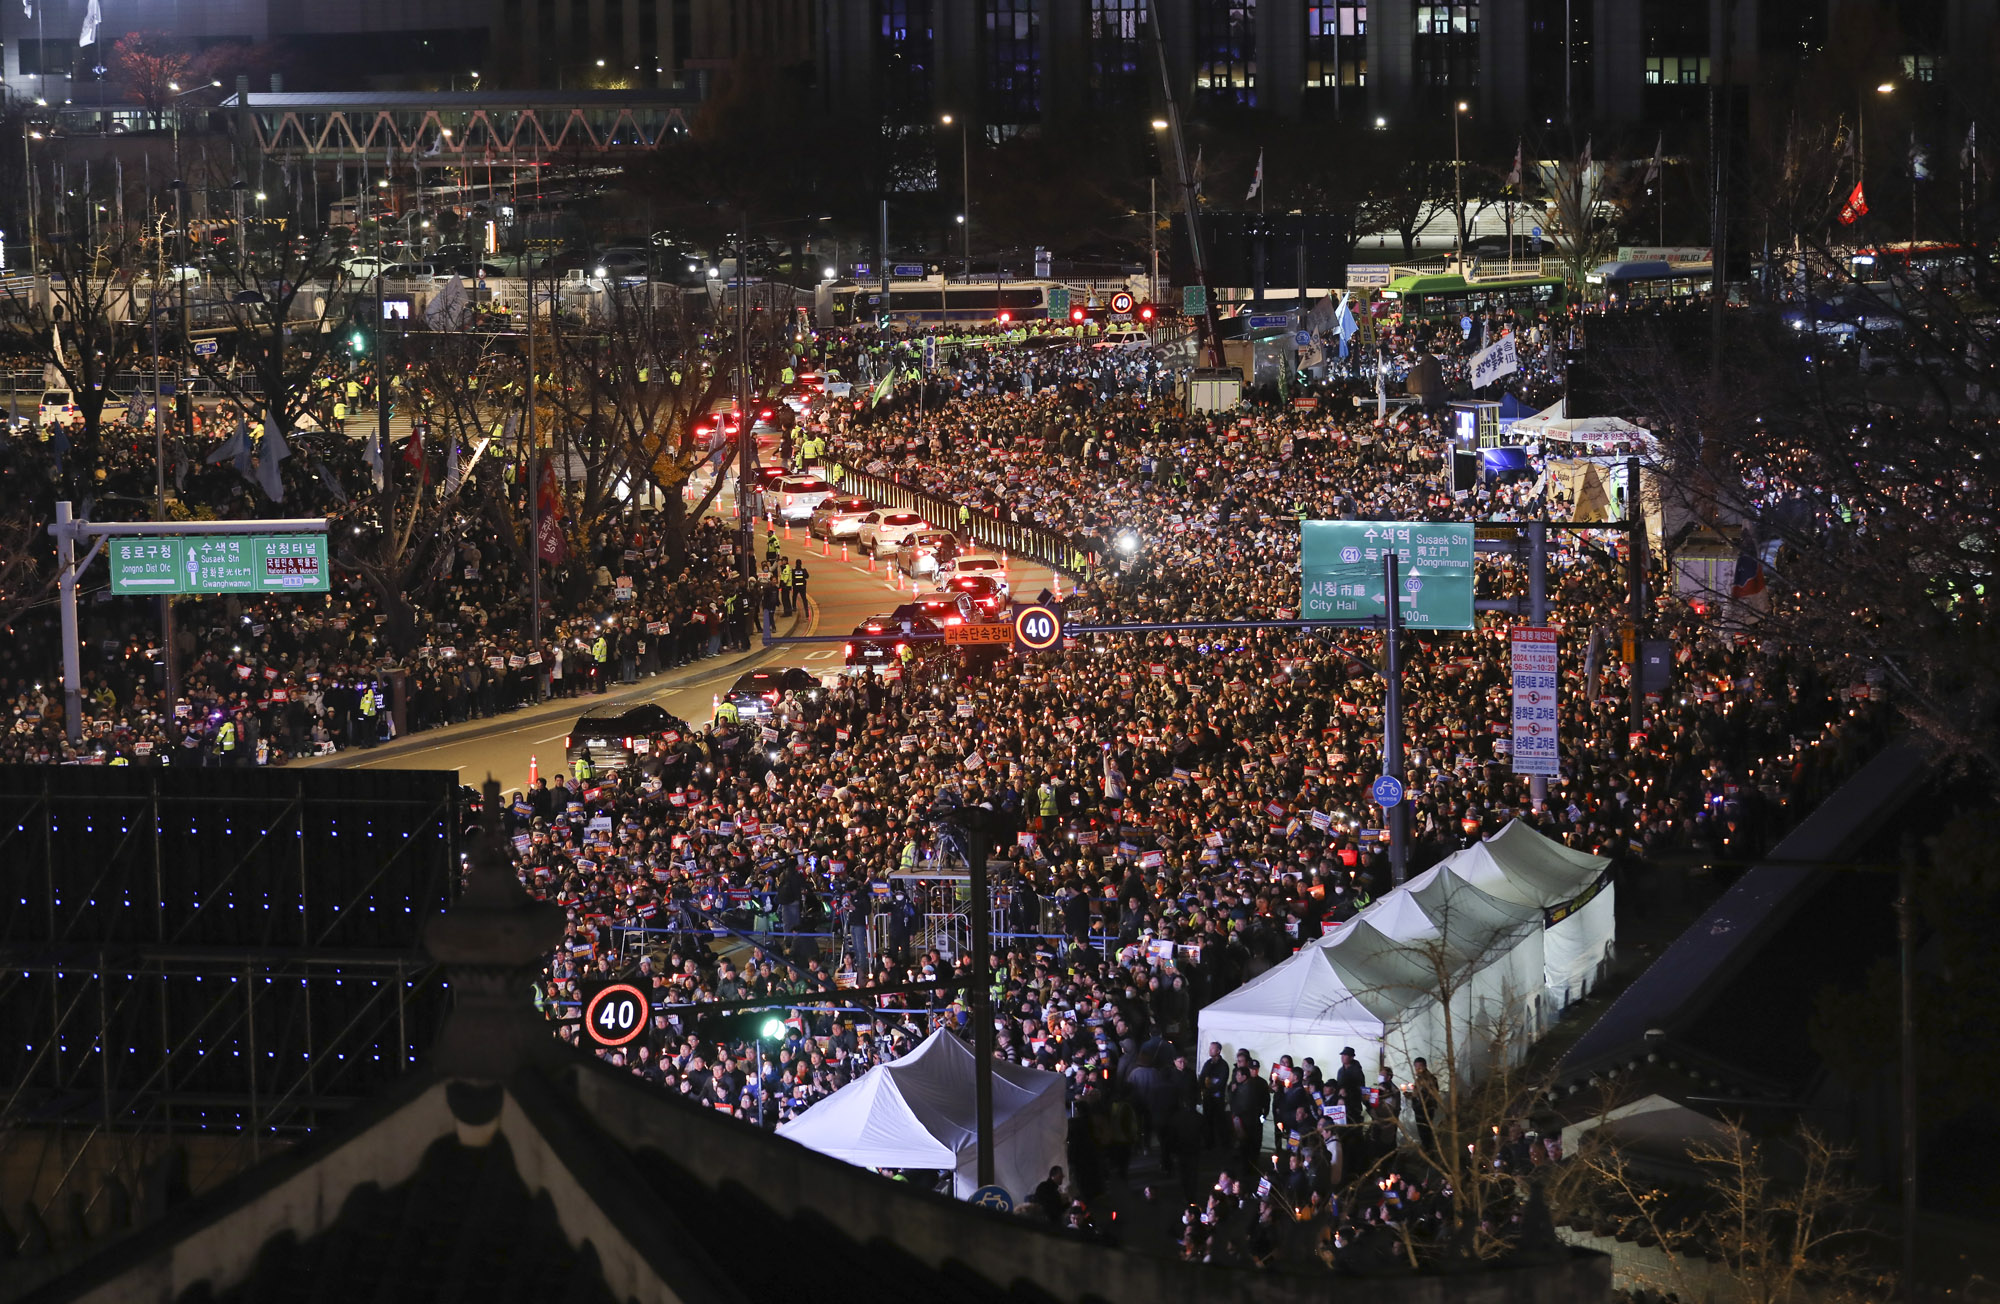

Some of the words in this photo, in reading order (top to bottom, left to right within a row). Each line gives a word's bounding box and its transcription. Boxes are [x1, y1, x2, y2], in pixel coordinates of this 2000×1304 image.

[1116, 297, 1129, 308] 40
[1363, 528, 1411, 544] 수색역
[1416, 534, 1449, 546] Susaek
[1451, 534, 1468, 545] Stn
[120, 544, 171, 560] 종로구청
[201, 541, 240, 554] 수색역
[265, 542, 316, 555] 삼청터널
[1417, 546, 1449, 557] 獨立門
[201, 554, 226, 563] Susaek
[228, 554, 240, 563] Stn
[1345, 550, 1357, 560] 21
[122, 564, 144, 574] Jongno
[145, 563, 158, 573] Dist
[160, 563, 171, 573] Ofc
[267, 558, 294, 568] 국립민속
[297, 557, 318, 568] 박물관
[1416, 557, 1469, 569] Dongnimmun
[201, 567, 224, 578] 광화문
[268, 567, 287, 575] National
[202, 579, 251, 589] Gwanghwamun
[1308, 580, 1338, 597] 시청
[1340, 584, 1366, 597] 市廳
[1407, 580, 1419, 590] 50
[1309, 599, 1333, 612] City
[1336, 600, 1358, 611] Hall
[947, 626, 1012, 641] 과속단속장비
[1025, 617, 1051, 638] 40
[1513, 630, 1555, 641] 교통통제안내
[1514, 674, 1537, 689] 세종대로
[1538, 675, 1555, 689] 교차로
[1515, 706, 1535, 720] 광화문
[1536, 707, 1555, 720] 교차로
[1515, 736, 1535, 750] 숭례문
[1536, 736, 1555, 750] 교차로
[599, 1000, 634, 1030] 40
